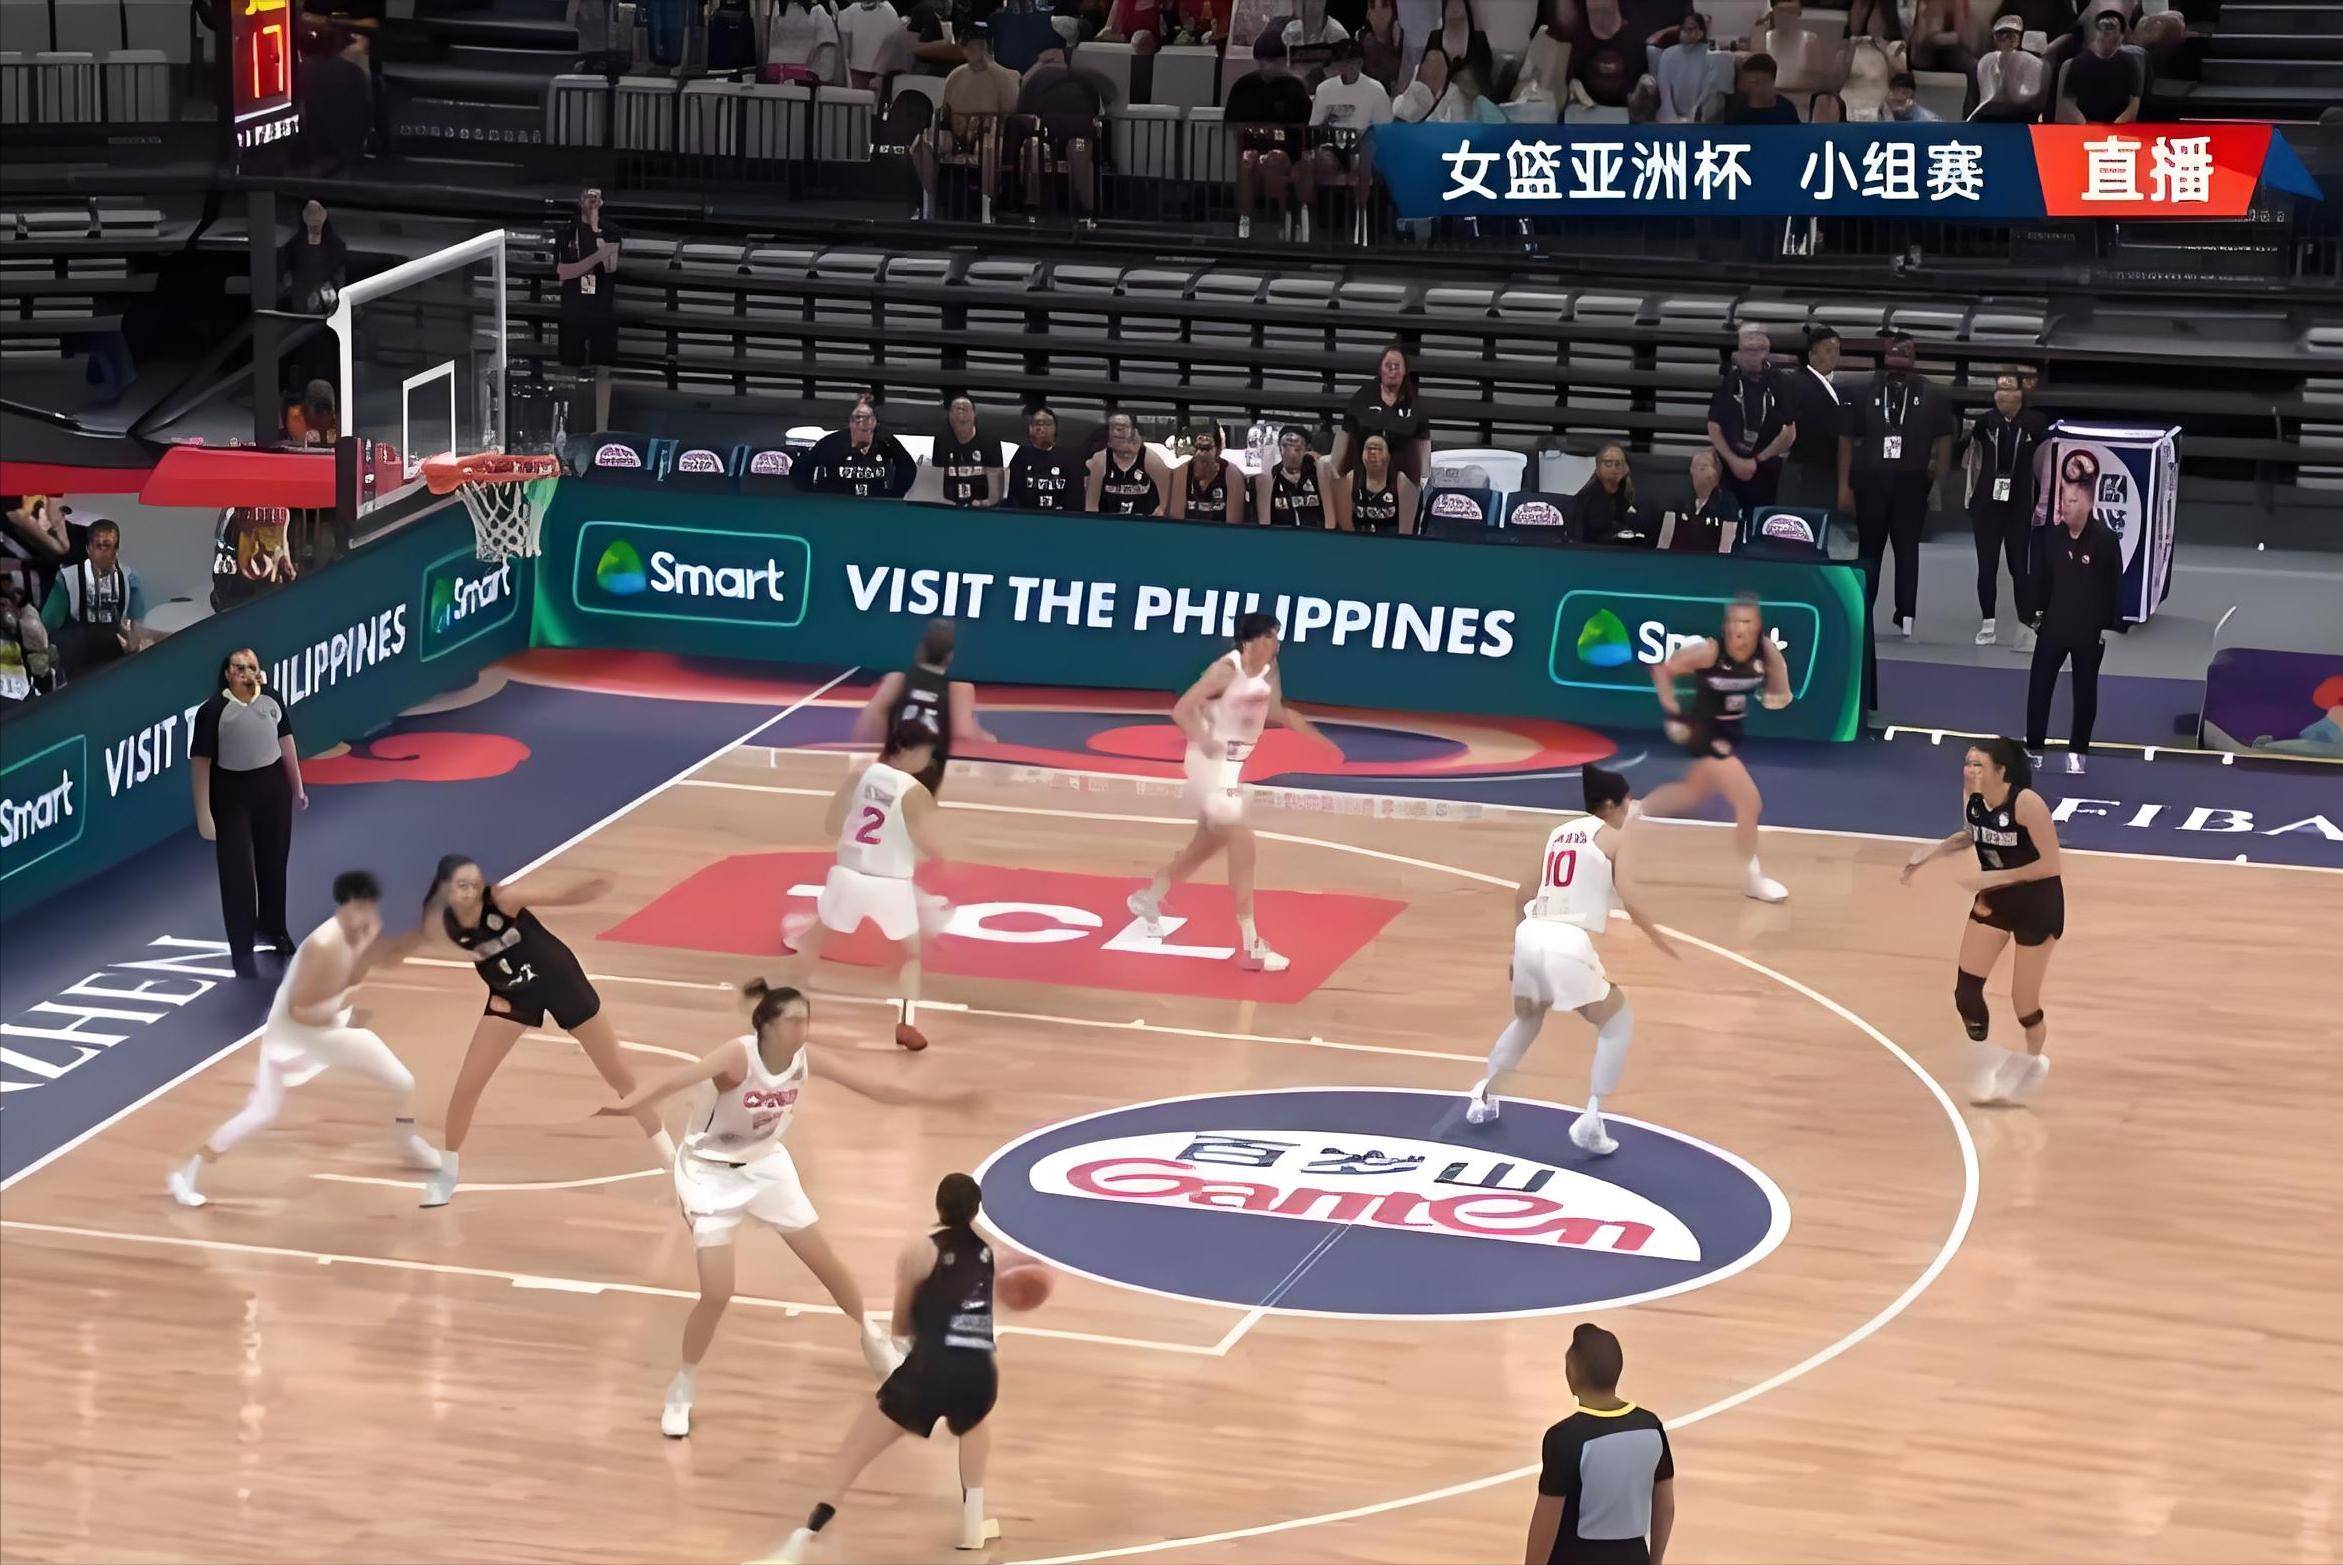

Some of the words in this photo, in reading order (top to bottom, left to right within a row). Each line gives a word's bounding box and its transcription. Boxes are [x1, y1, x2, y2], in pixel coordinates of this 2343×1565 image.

[252, 24, 284, 98] 17
[650, 551, 785, 602] Smart
[846, 564, 995, 619] VISIT
[1008, 575, 1117, 629] THE
[105, 714, 178, 797] VISIT
[0, 769, 74, 848] Smart
[855, 806, 886, 846] 2
[1545, 849, 1577, 888] 10
[1066, 1157, 1655, 1251] Ganten
